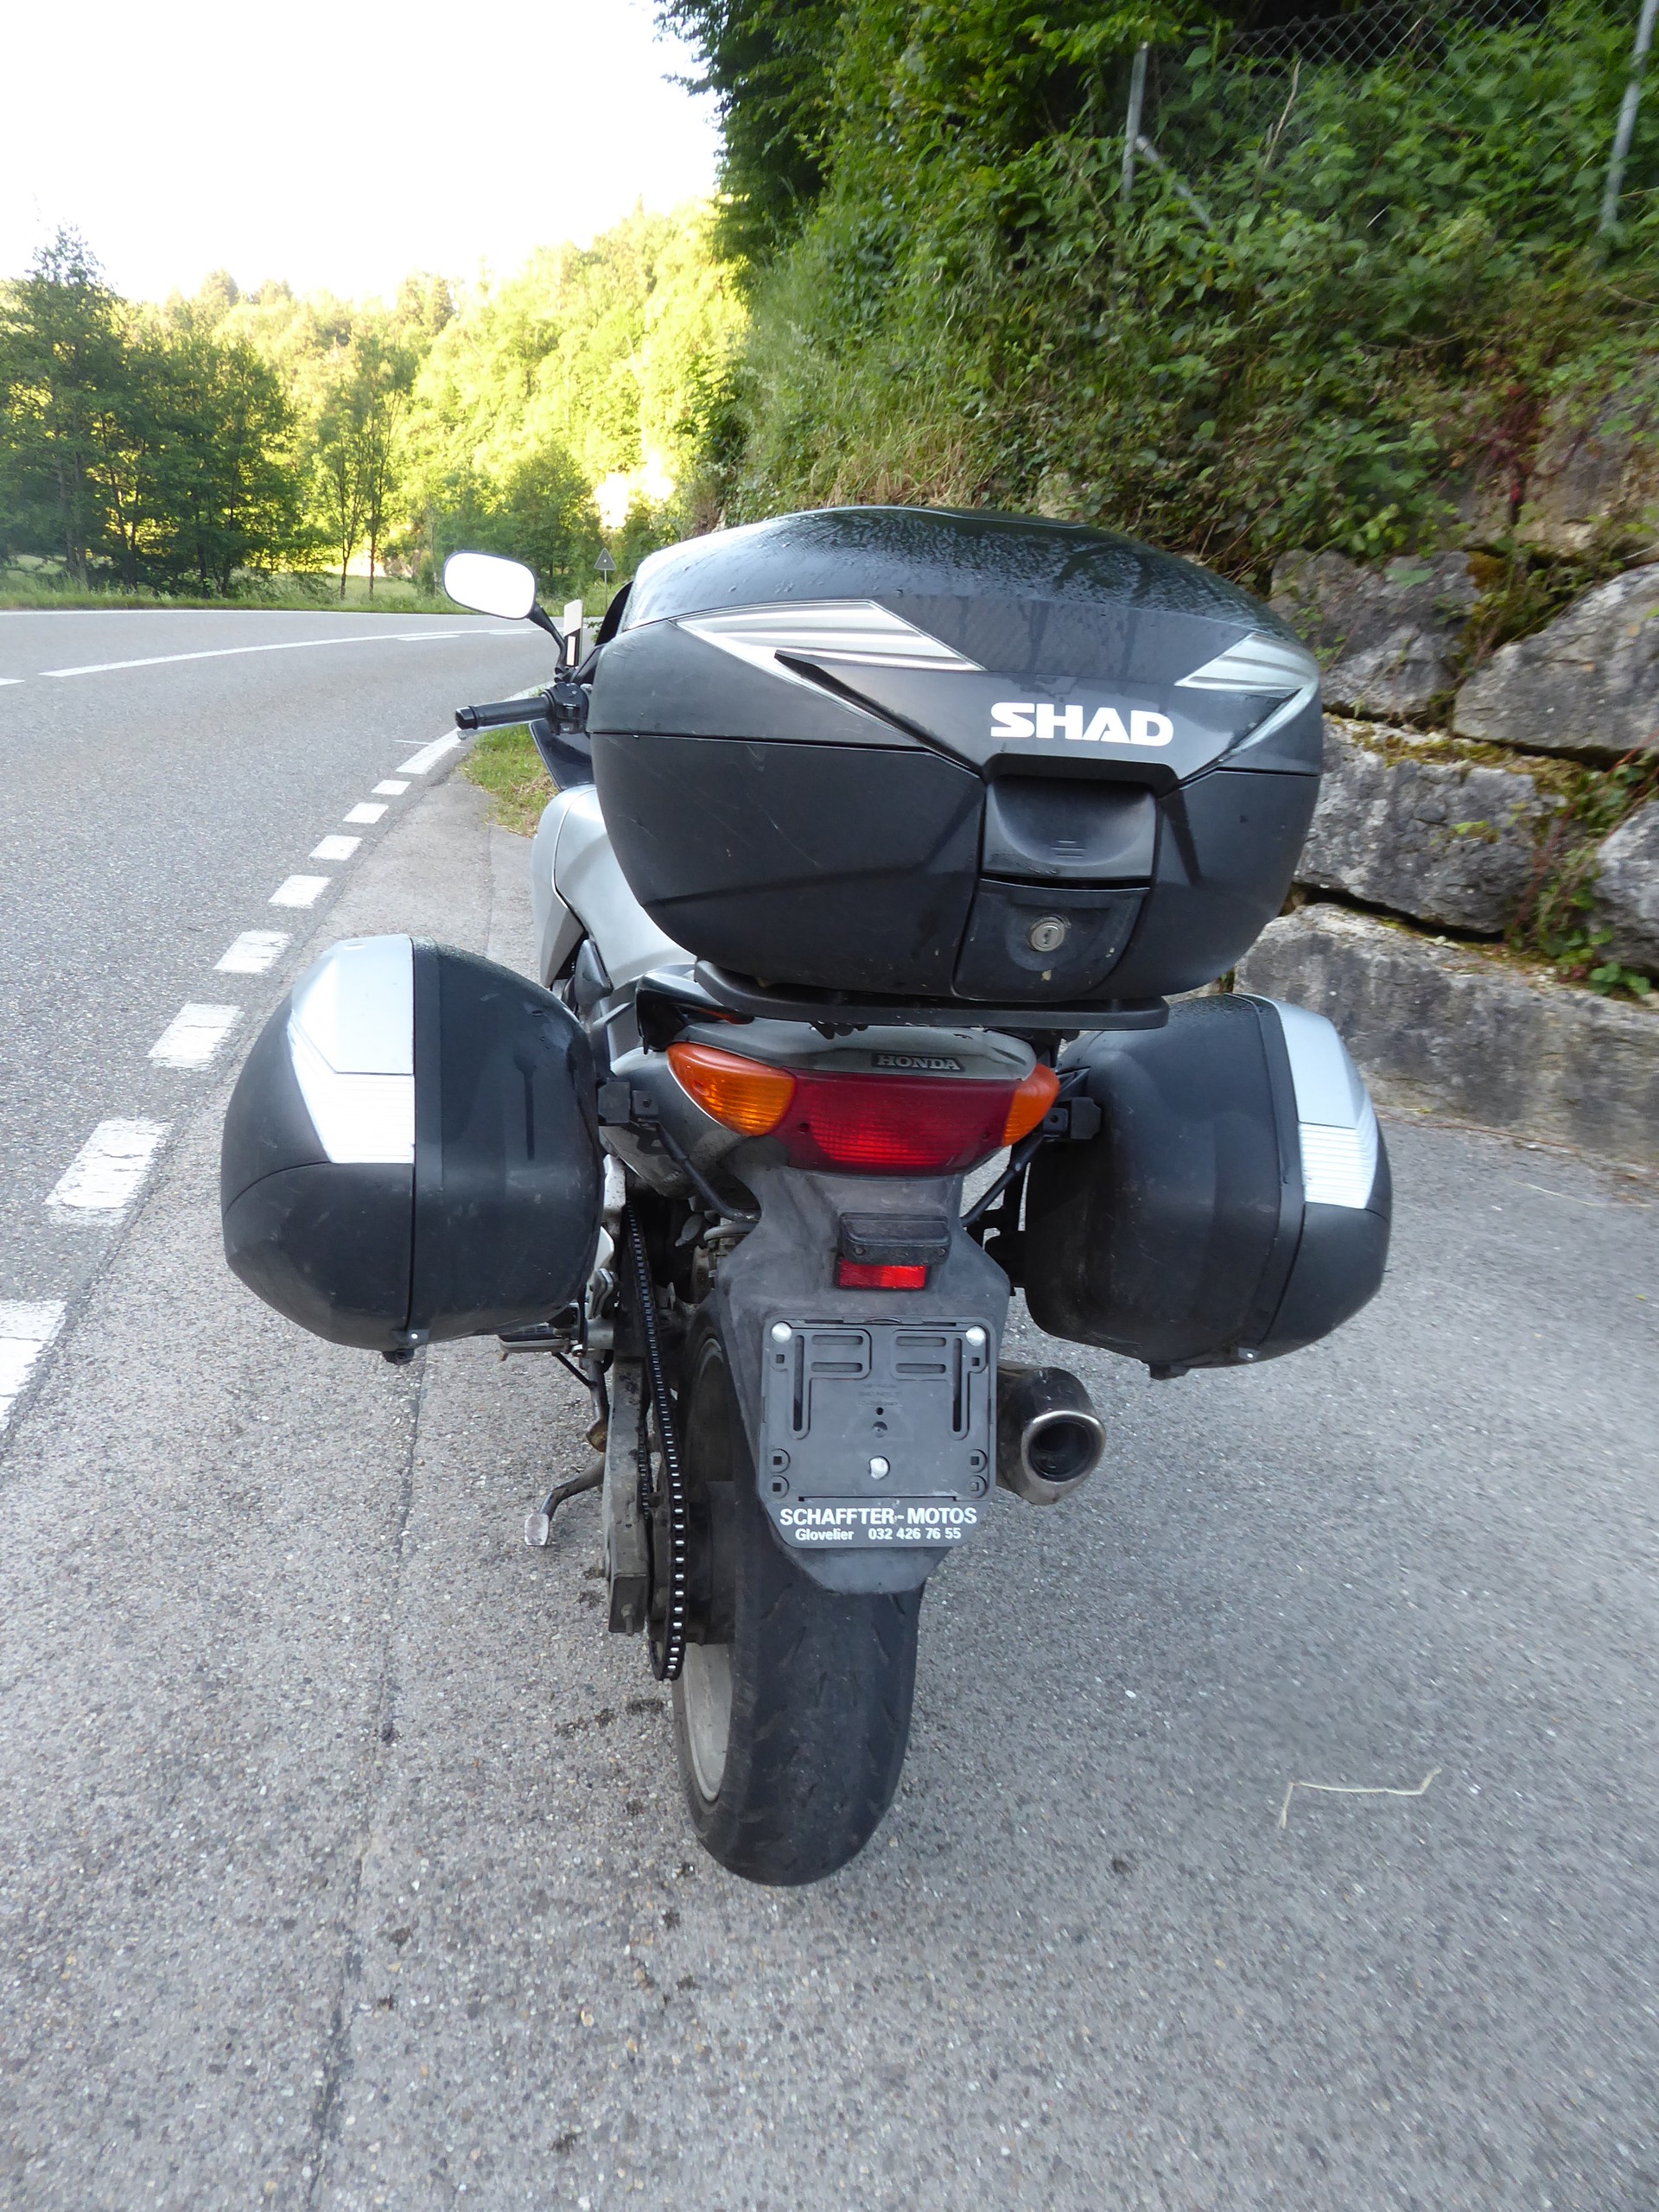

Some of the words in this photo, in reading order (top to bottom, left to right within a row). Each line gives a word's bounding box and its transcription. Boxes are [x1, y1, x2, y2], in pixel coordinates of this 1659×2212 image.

[990, 702, 1173, 747] SHAD
[877, 1054, 960, 1070] HONDA
[795, 1528, 855, 1541] Glovelier
[868, 1528, 893, 1540] 032
[896, 1527, 922, 1540] 426
[925, 1527, 941, 1539] 76
[944, 1527, 962, 1539] 55
